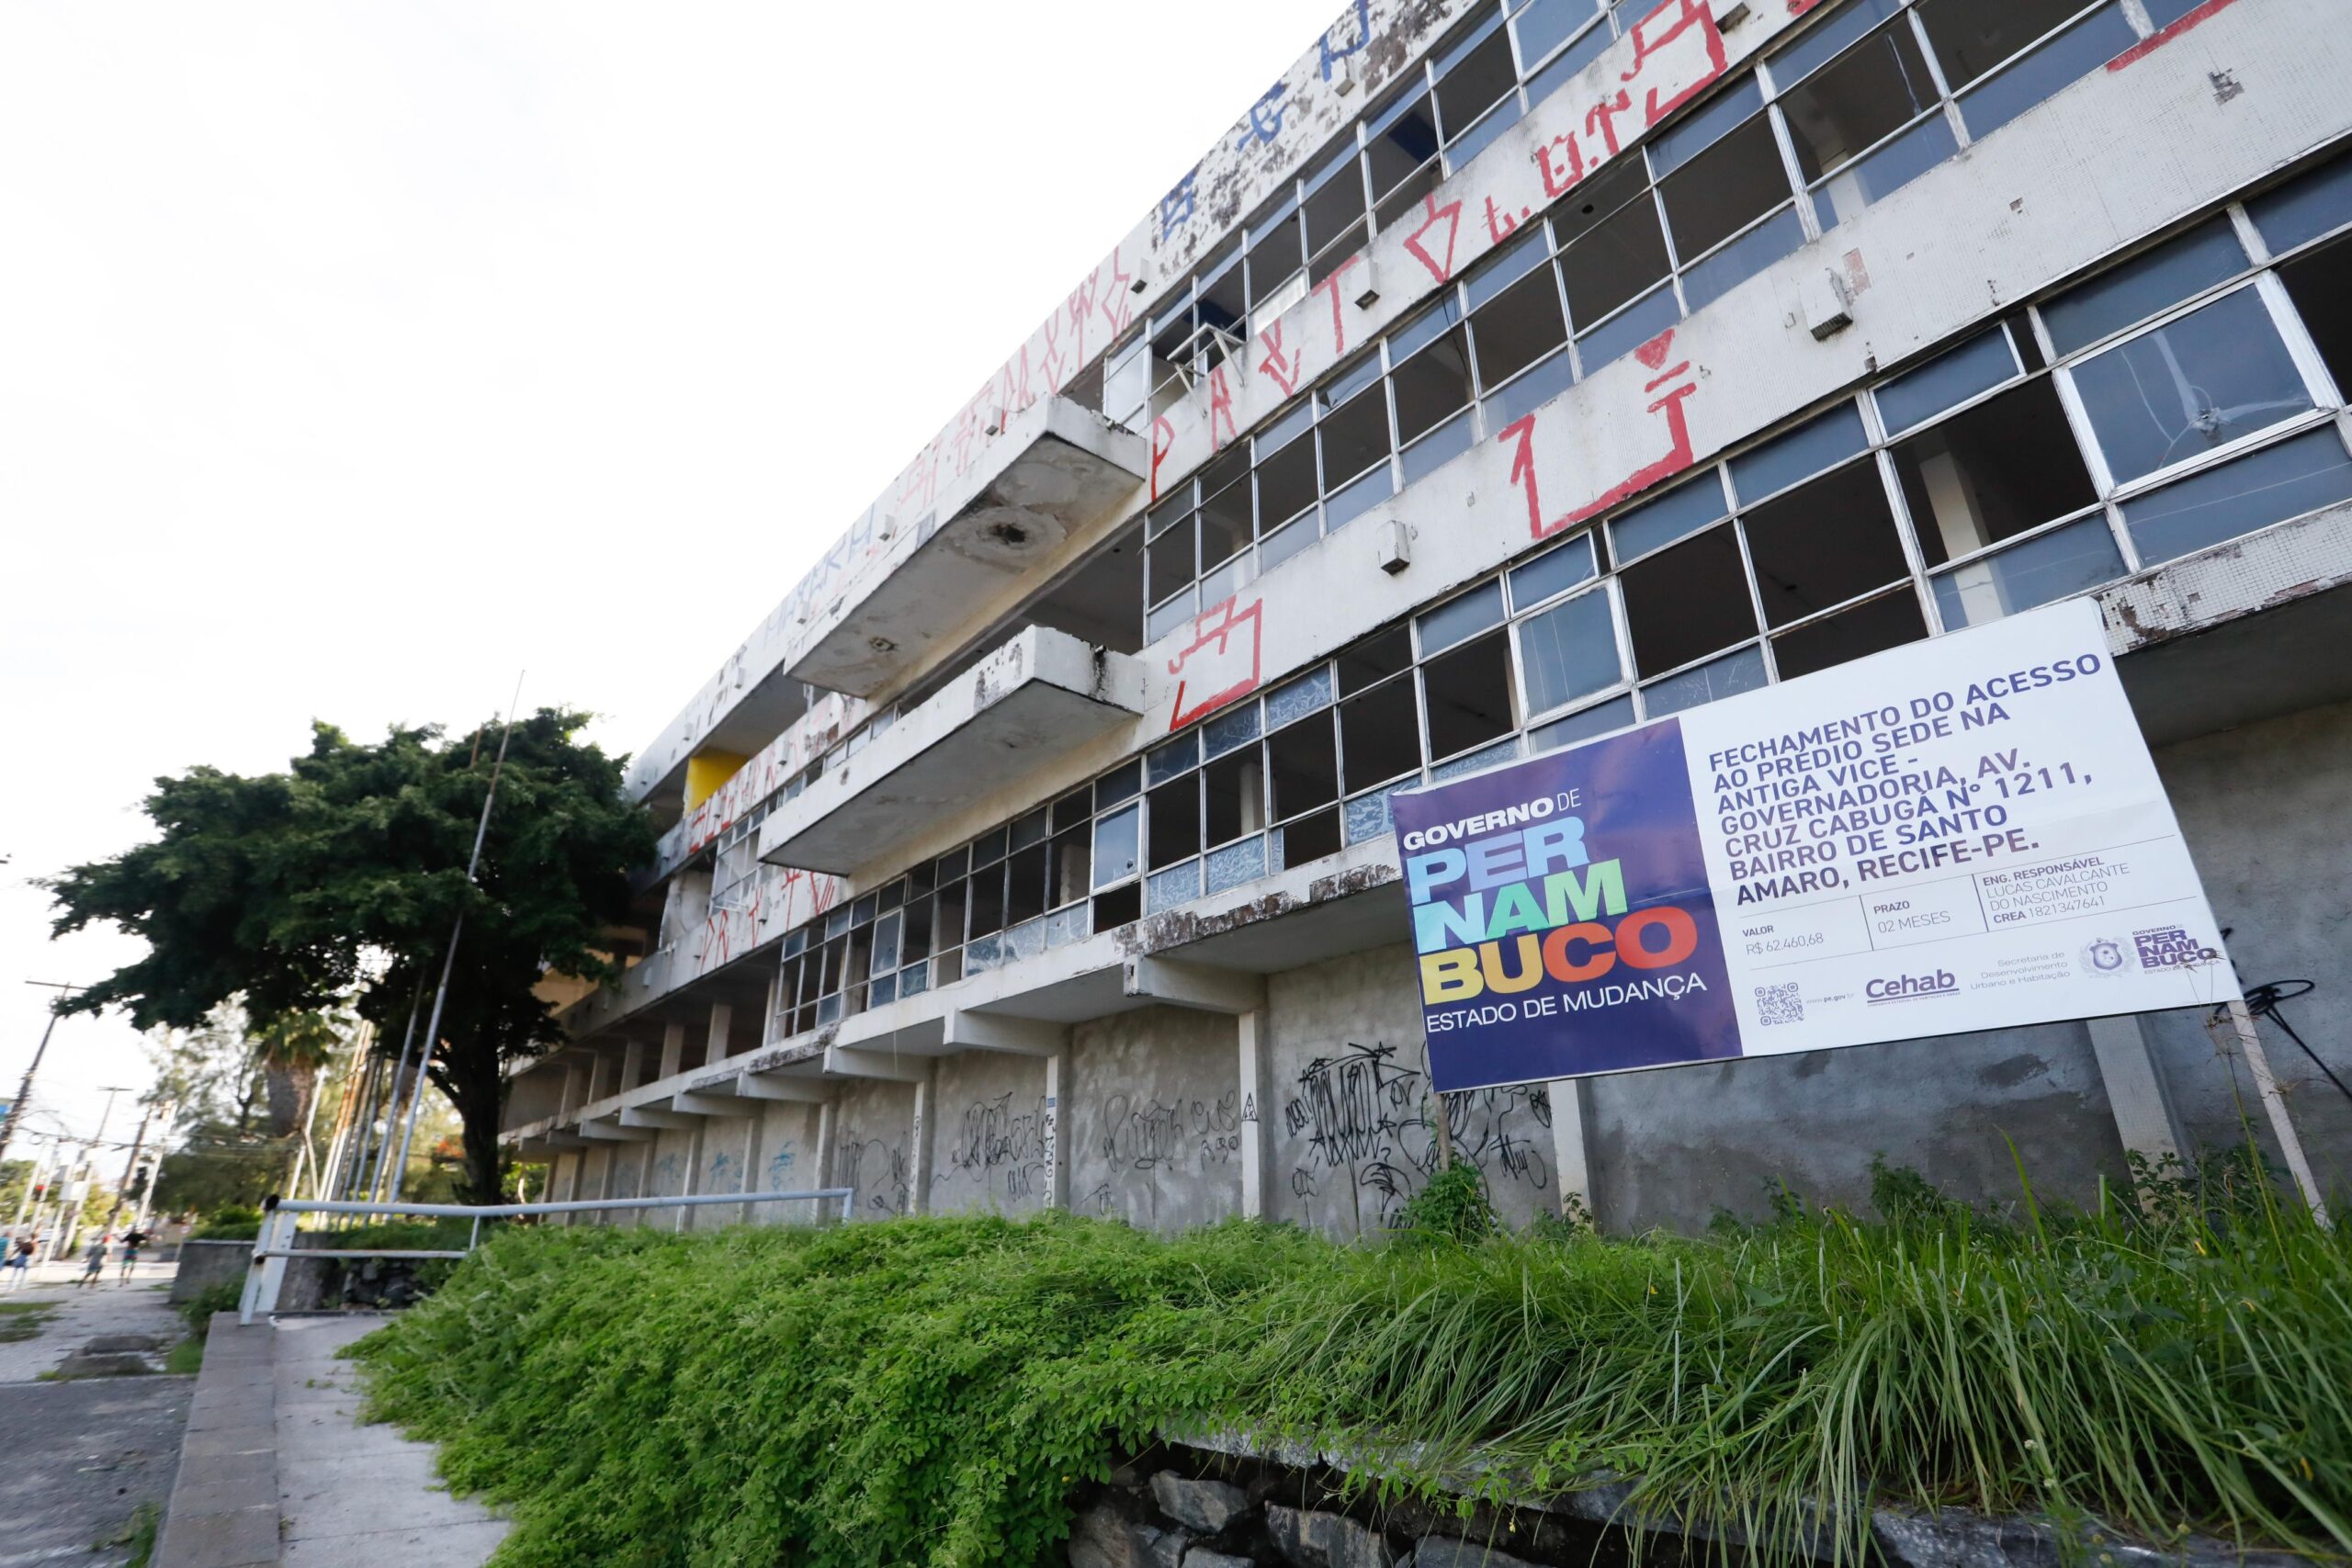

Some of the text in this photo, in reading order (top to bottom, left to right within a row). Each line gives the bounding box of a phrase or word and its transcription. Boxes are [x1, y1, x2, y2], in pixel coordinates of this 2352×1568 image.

[1710, 653, 2101, 773] FECHAMENTO DO ACESSO
[1713, 702, 2011, 794] AO PRÉDIO SEDE NA
[1717, 774, 1826, 815] ANTIGA
[1827, 753, 1900, 787] VICE
[1721, 748, 2031, 836] GOVERNADORIA, AV.
[1403, 787, 1581, 851] GOVERNO DE
[1724, 824, 1802, 858] CRUZ
[1808, 791, 1939, 840] CABUGÁ
[1995, 761, 2093, 799] 1211,
[1729, 805, 2007, 881] BAIRRO DE SANTO
[1406, 816, 1590, 906] PER
[1736, 828, 2040, 906] AMARO, RECIFE-PE.
[1983, 856, 2105, 886] ENG. RESPONSÁVEL
[1985, 863, 2131, 899] LUCAS CAVALCANTE
[1989, 880, 2108, 911] DO NASCIMENTO
[1412, 858, 1629, 954] NAM
[1873, 900, 1911, 915] PRAZO
[1993, 895, 2106, 924] CREA 1821347641
[1742, 924, 1775, 938] VALOR
[1877, 910, 1951, 933] 02 MESES
[2132, 924, 2177, 936] GOVERNO
[1746, 932, 1825, 956] R$ 62.460,68
[2133, 929, 2188, 948] PER
[2136, 938, 2199, 958] NAM
[1419, 906, 1699, 1006] BUCO
[1980, 961, 2068, 979] Desenvolvimento
[1997, 953, 2049, 967] Secretaria
[2140, 947, 2218, 969] BUCO
[1865, 968, 1956, 998] Cehab
[1970, 979, 2007, 990] Urbano
[2018, 970, 2071, 984] Habitação
[1427, 972, 1708, 1033] ESTADO DE MUDANÇA
